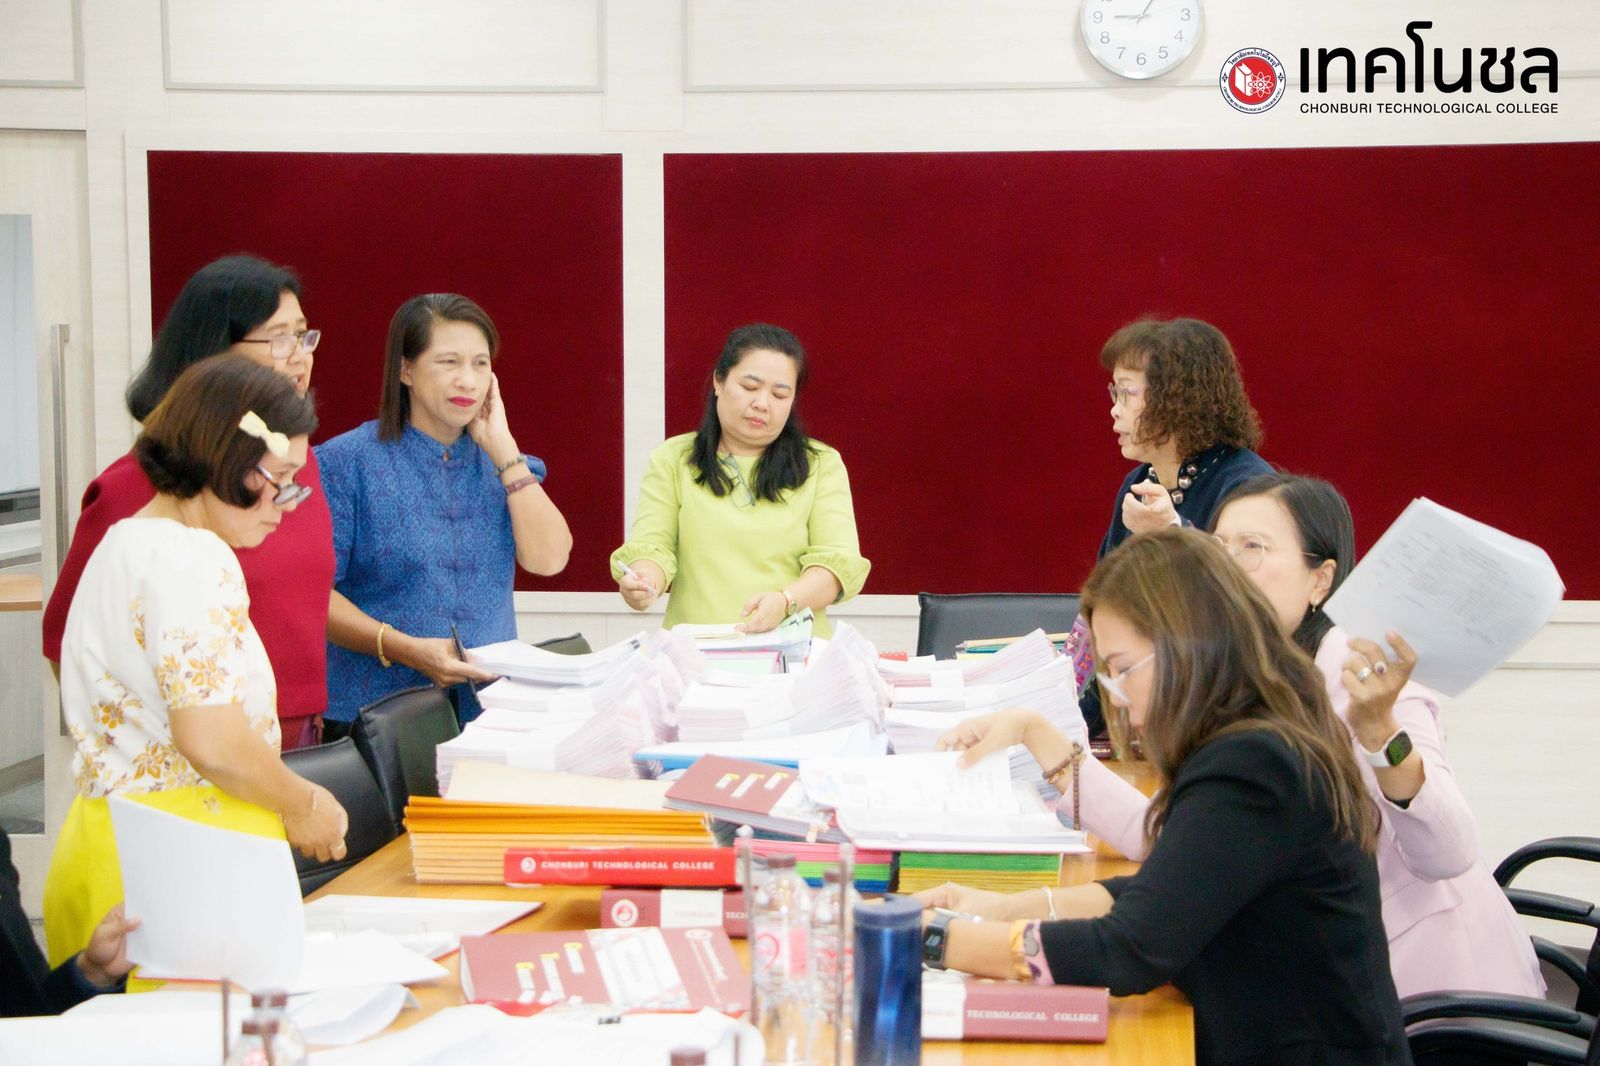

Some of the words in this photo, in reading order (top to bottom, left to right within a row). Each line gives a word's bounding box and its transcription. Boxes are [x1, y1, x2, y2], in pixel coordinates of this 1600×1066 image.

[1092, 10, 1103, 24] 9
[1180, 8, 1191, 21] 3
[1100, 31, 1110, 44] 8
[1173, 30, 1184, 43] 4
[1116, 46, 1126, 59] 7
[1136, 52, 1147, 66] 6
[1158, 46, 1168, 59] 5
[541, 861, 589, 870] CHONBURI
[592, 861, 669, 870] TECHNOLOGICAL
[672, 861, 715, 870] COLLEGE
[966, 1009, 1049, 1022] TECHNOLOGICAL
[1053, 1012, 1100, 1023] COLLEGE
